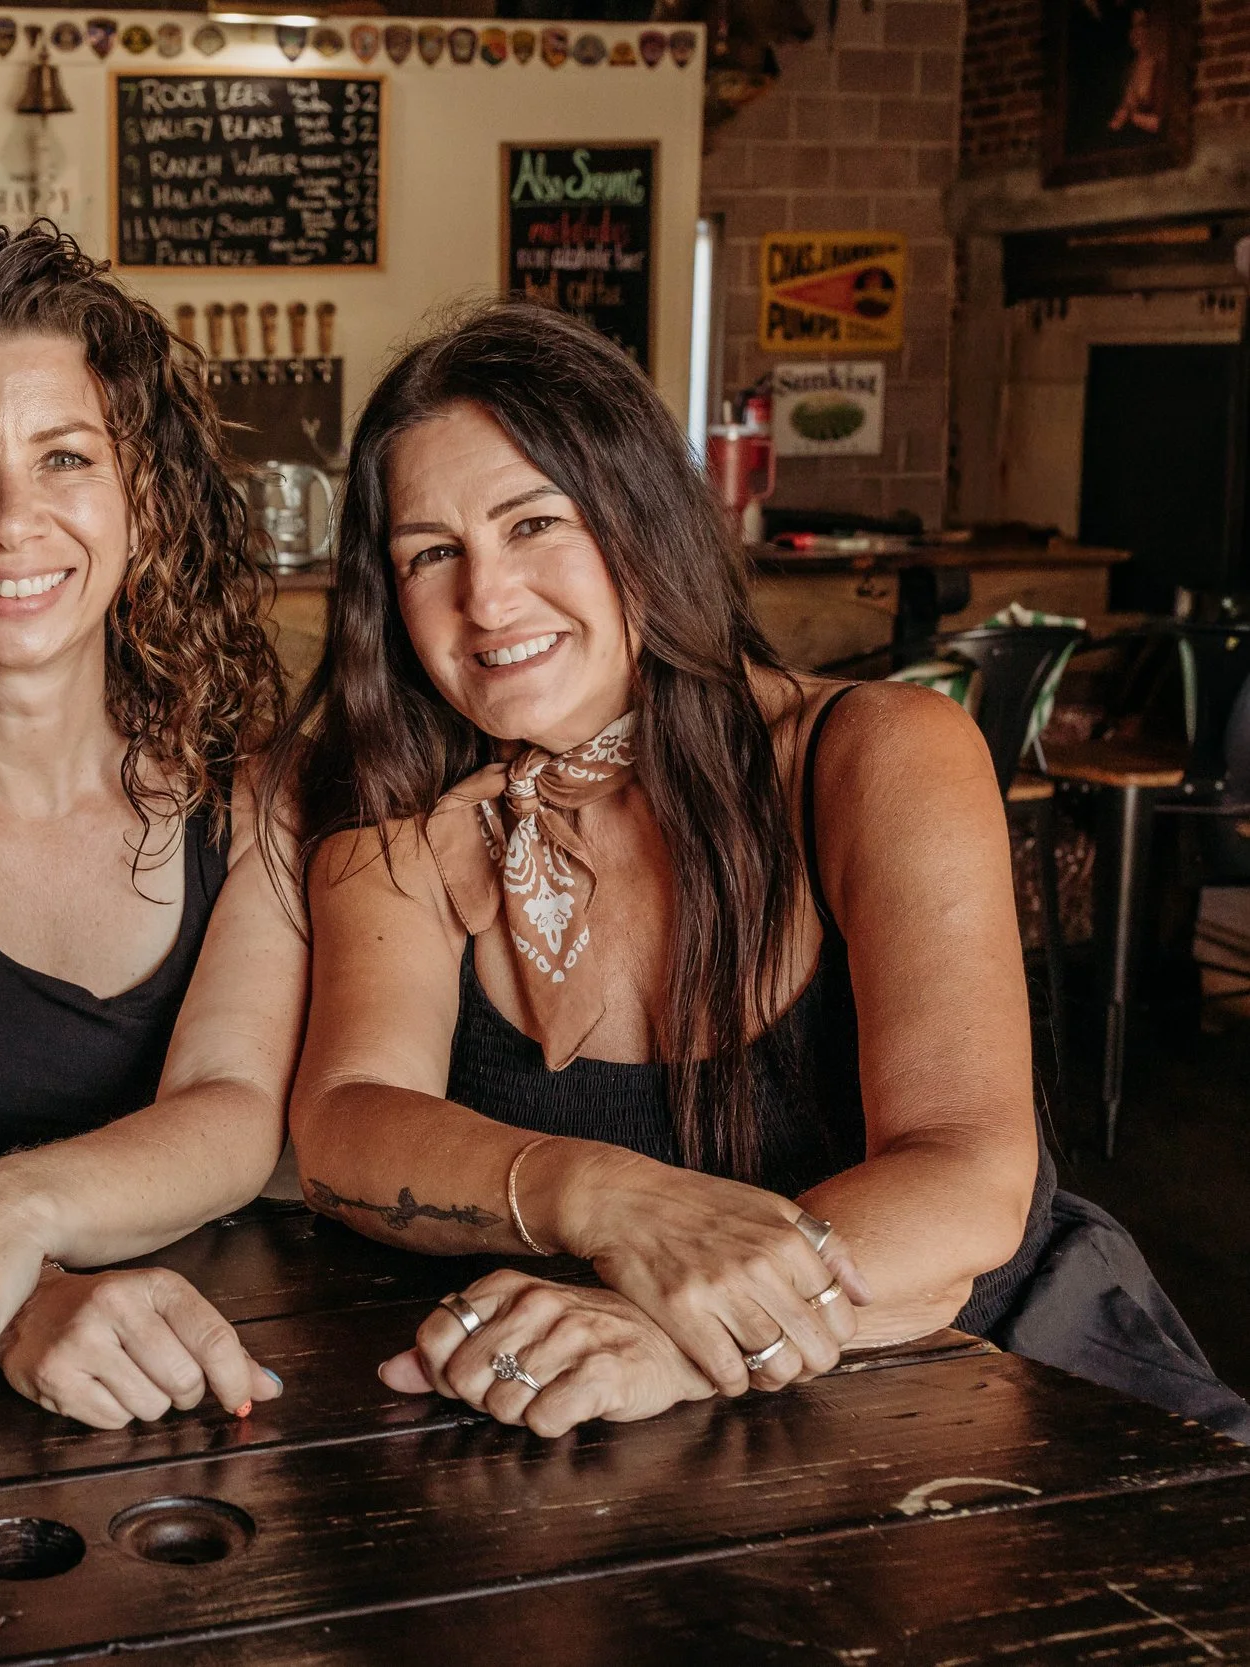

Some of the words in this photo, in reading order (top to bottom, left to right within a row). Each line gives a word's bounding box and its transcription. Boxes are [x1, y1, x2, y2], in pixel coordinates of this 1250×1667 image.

[139, 78, 207, 114] ROOT
[213, 80, 273, 111] BEER
[140, 115, 213, 144] VALLEY
[219, 114, 284, 142] BLAST
[149, 151, 223, 179] RANCH
[230, 144, 300, 176] WATER
[512, 149, 565, 201] Also
[565, 148, 645, 204] Serving
[767, 301, 841, 341] PUMPS
[772, 366, 877, 396] Sunkist
